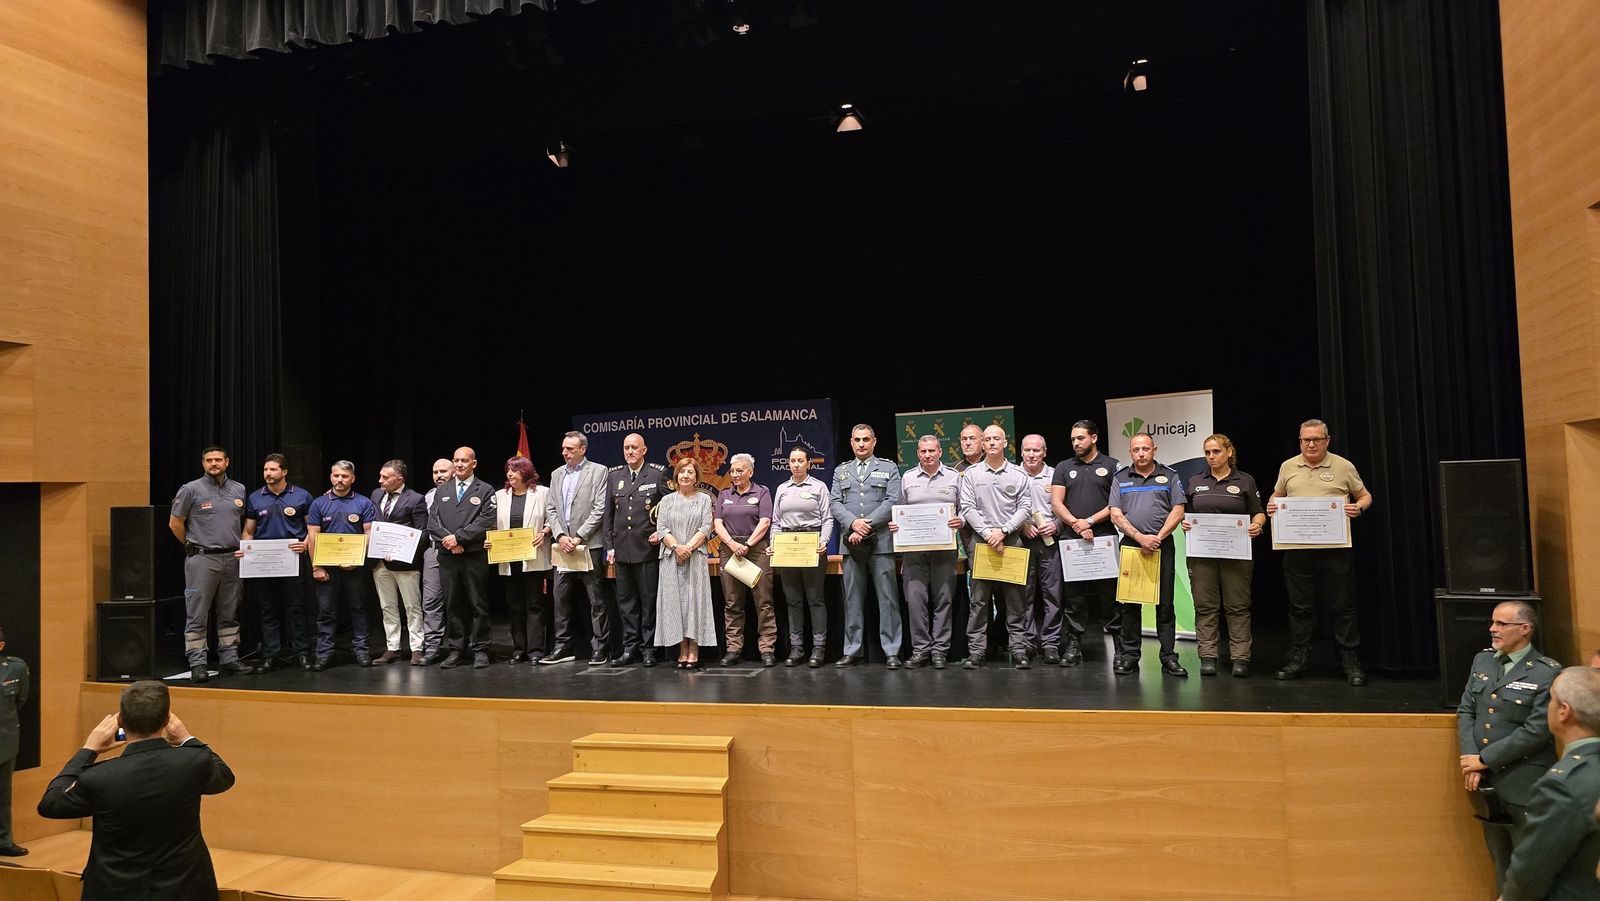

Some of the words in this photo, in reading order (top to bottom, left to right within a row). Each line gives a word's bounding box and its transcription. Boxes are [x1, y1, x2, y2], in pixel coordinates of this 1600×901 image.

[583, 416, 645, 434] COMISARÍA
[648, 413, 718, 429] PROVINCIAL
[721, 412, 738, 424] DE
[741, 409, 818, 423] SALAMANCA
[1147, 421, 1196, 437] Unicaja
